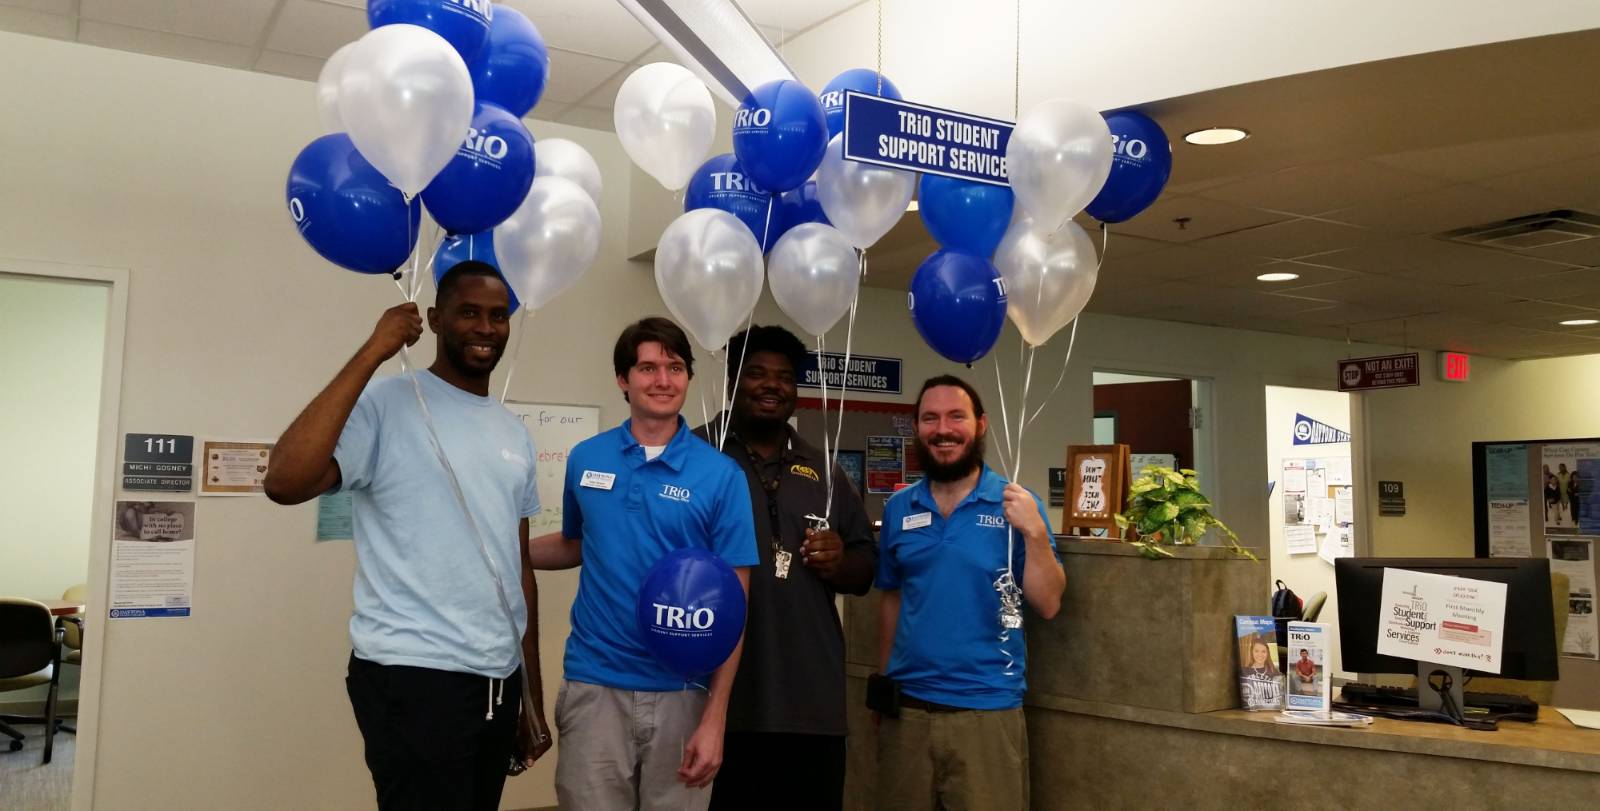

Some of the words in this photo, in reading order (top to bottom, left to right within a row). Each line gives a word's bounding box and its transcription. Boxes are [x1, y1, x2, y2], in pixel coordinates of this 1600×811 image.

[820, 88, 844, 109] TRi
[898, 110, 932, 138] TRiO
[935, 119, 1001, 150] STUDENT
[464, 127, 509, 160] RiO
[878, 134, 945, 167] SUPPORT
[949, 152, 1008, 179] SERVICE
[838, 359, 877, 373] STUDENT
[1446, 353, 1469, 379] EXIT
[805, 370, 845, 385] SUPPORT
[846, 373, 888, 389] SERVICES
[538, 410, 555, 427] for
[559, 415, 584, 424] our
[144, 438, 176, 454] 111
[156, 464, 187, 472] GOSNEY
[1056, 470, 1067, 481] 11
[125, 477, 157, 485] ASSOCIATE
[160, 478, 190, 486] DIRECTOR
[1383, 483, 1399, 493] 109
[662, 484, 690, 499] TRiO
[977, 514, 1004, 525] TRiO
[652, 602, 715, 630] TRiO
[1393, 606, 1425, 620] Student
[1405, 618, 1437, 631] Support
[1386, 629, 1420, 643] Services
